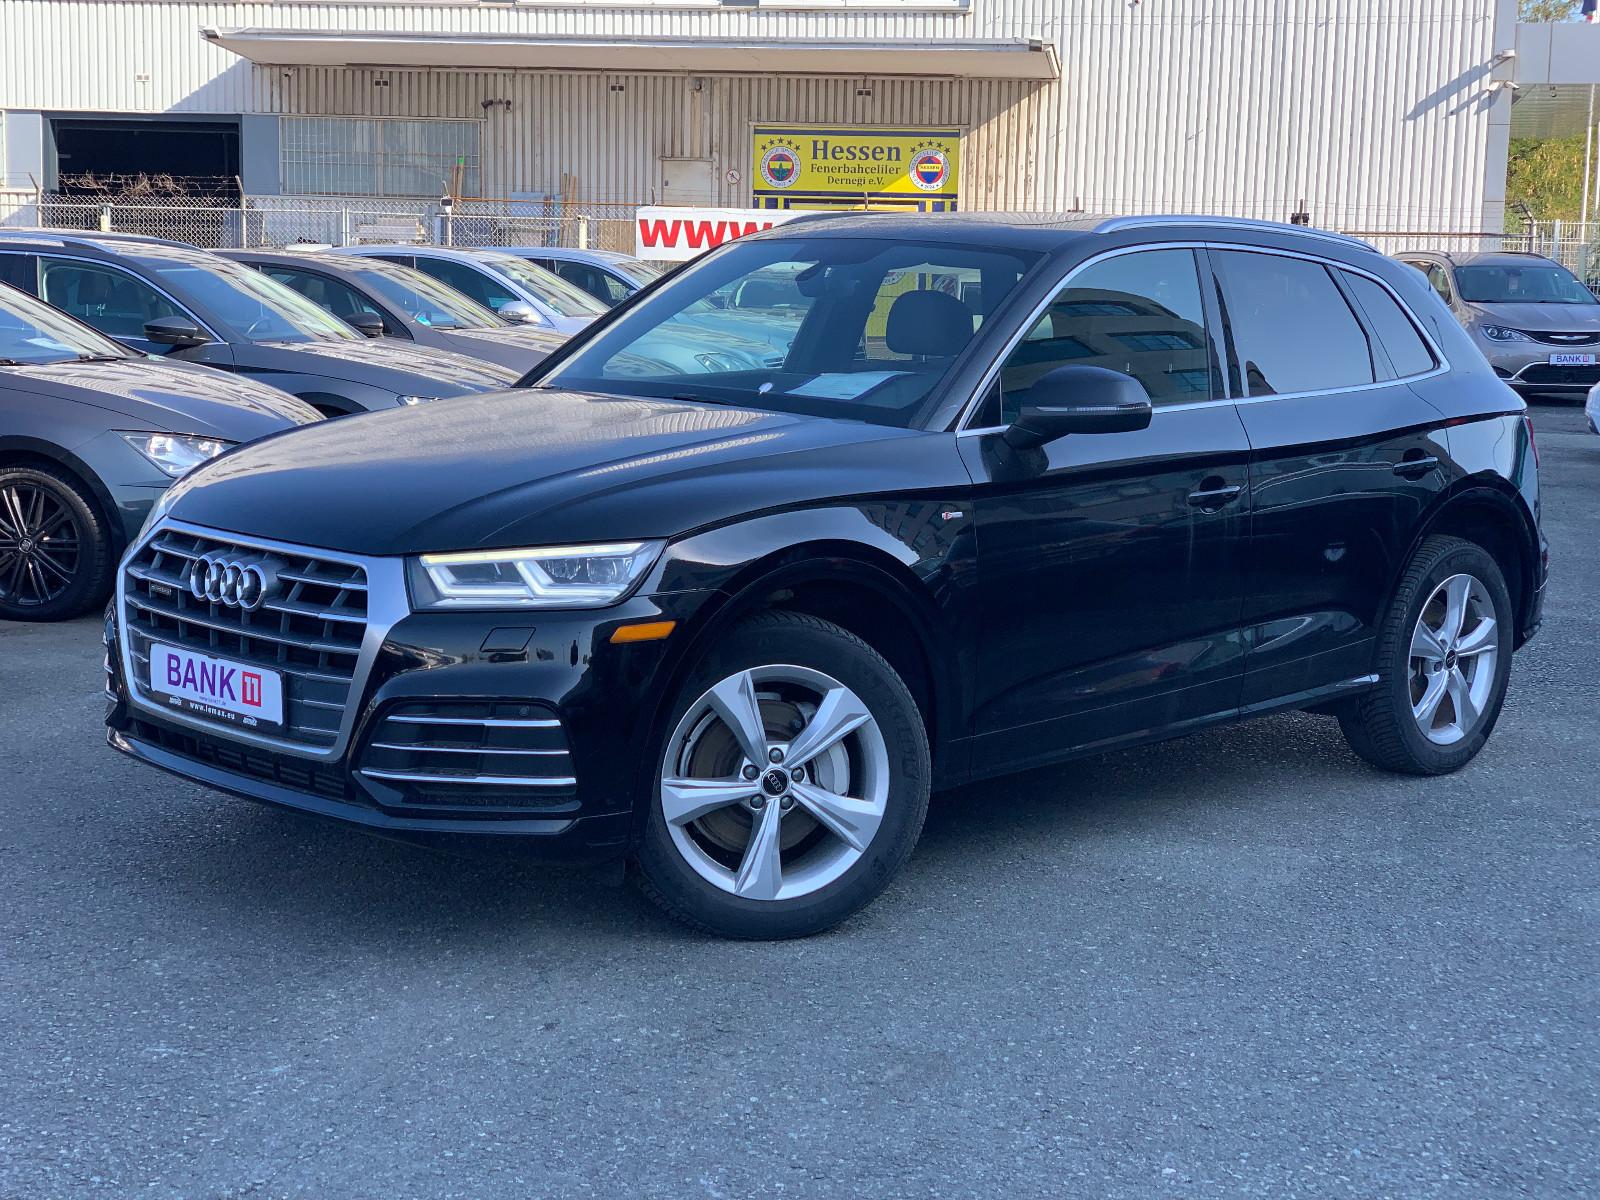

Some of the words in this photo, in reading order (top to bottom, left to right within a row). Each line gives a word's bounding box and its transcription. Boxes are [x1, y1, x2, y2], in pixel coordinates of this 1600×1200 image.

[811, 139, 901, 161] Hessen
[810, 163, 901, 175] Fenerbahçeliler
[1556, 355, 1581, 363] BANK
[167, 652, 237, 702] BANK
